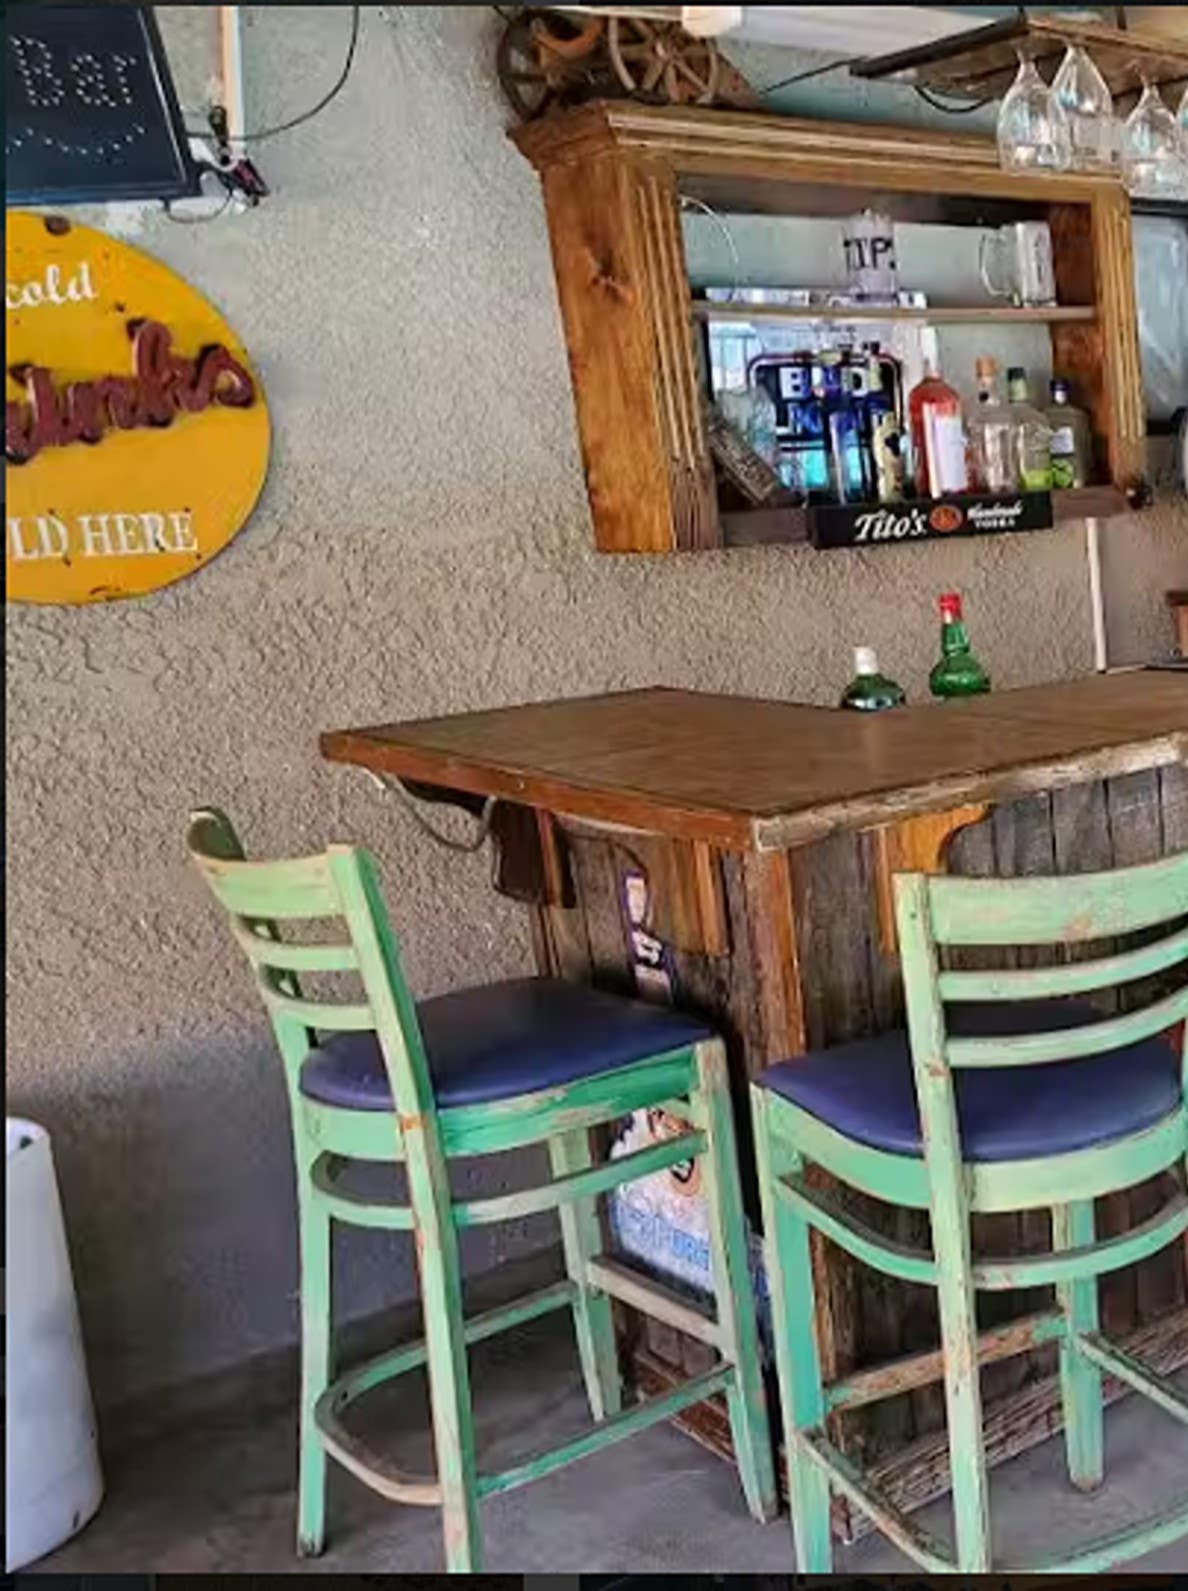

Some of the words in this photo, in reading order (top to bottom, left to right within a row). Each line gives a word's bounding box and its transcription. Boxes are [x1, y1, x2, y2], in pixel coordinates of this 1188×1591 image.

[10, 36, 138, 107] Bar
[6, 262, 98, 309] cold
[77, 512, 199, 557] HERE
[855, 508, 927, 542] Tito's
